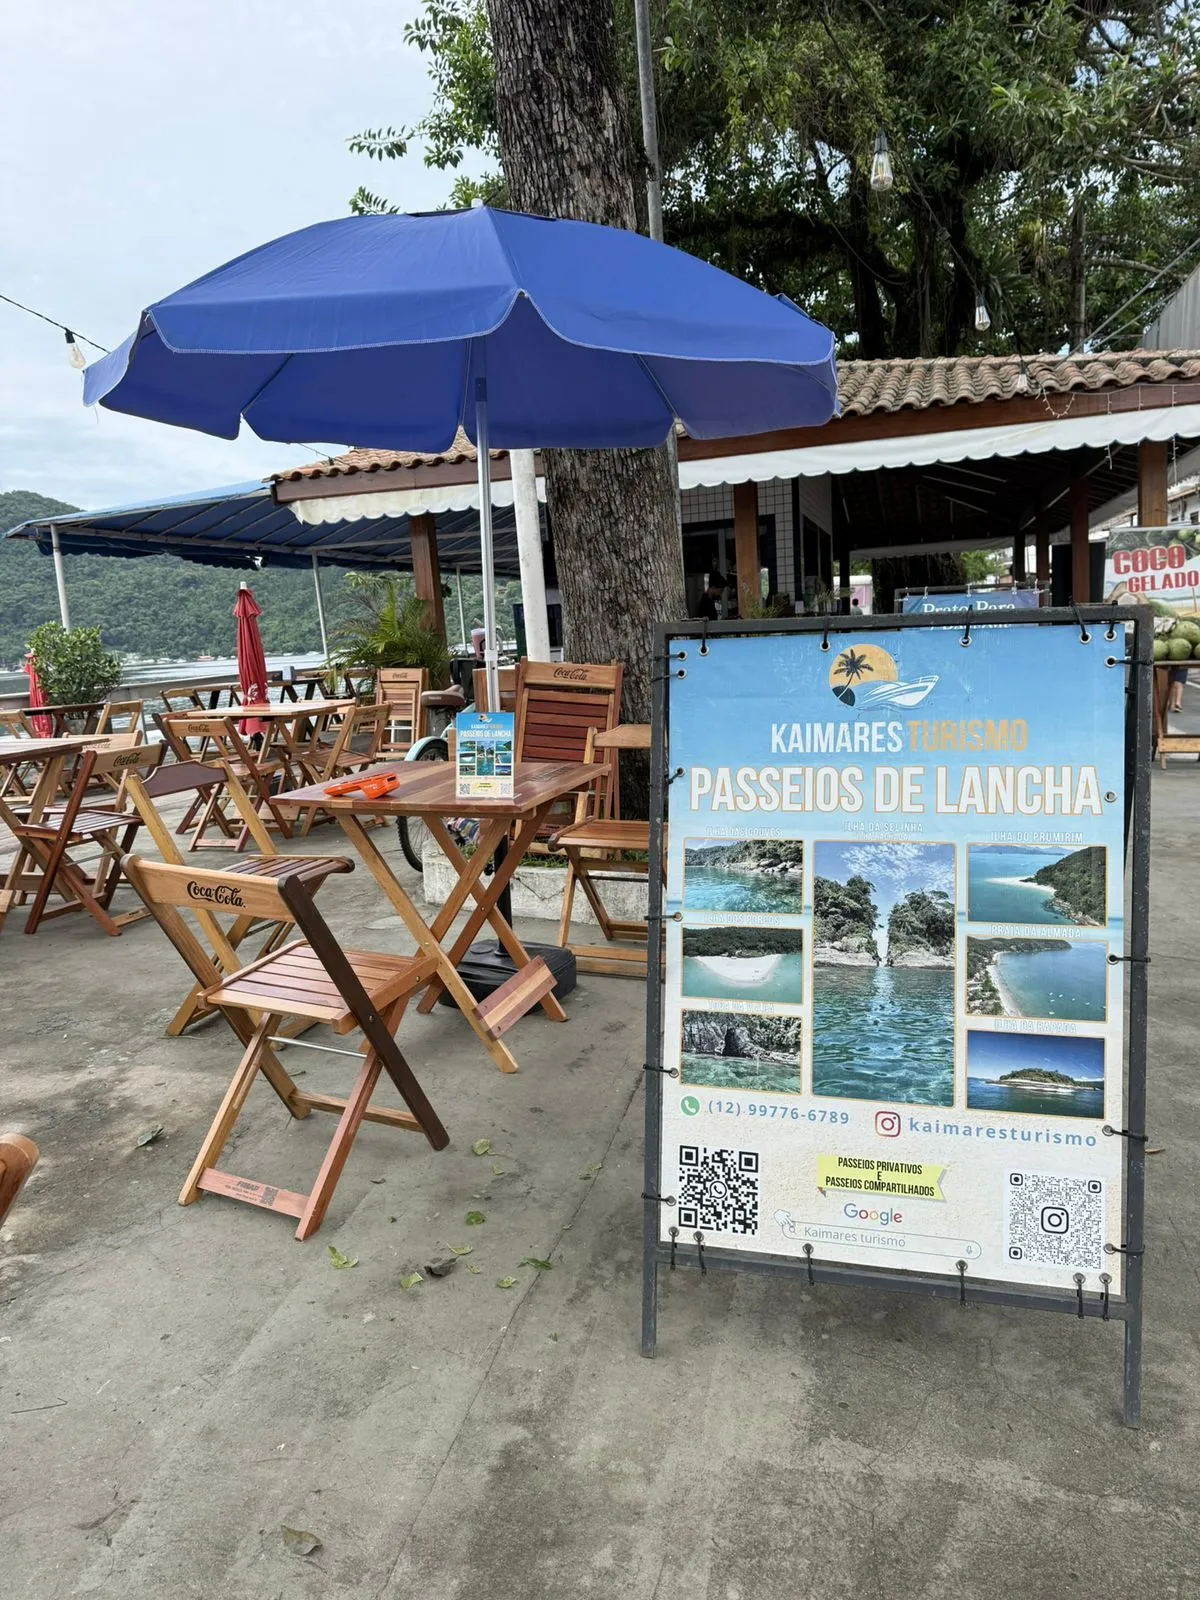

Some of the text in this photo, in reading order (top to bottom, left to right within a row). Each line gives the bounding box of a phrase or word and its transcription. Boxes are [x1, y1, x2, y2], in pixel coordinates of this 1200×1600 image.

[1112, 544, 1185, 575] COCO
[1127, 570, 1199, 593] GELADO
[688, 765, 1103, 816] PASSEIOS DE LANCHA
[991, 831, 1013, 841] ILHA
[991, 925, 1020, 936] PRAIA
[708, 1100, 850, 1124] (12) 99776-6789
[909, 1117, 1098, 1147] kaimaresturismo
[838, 1157, 922, 1175] PASSEIOS PRIVATIVOS
[877, 1171, 882, 1181] E
[825, 1176, 935, 1197] PASSEIOS COMPARTILHADOS
[843, 1203, 903, 1226] Google
[804, 1226, 906, 1248] Kaimares turismo
